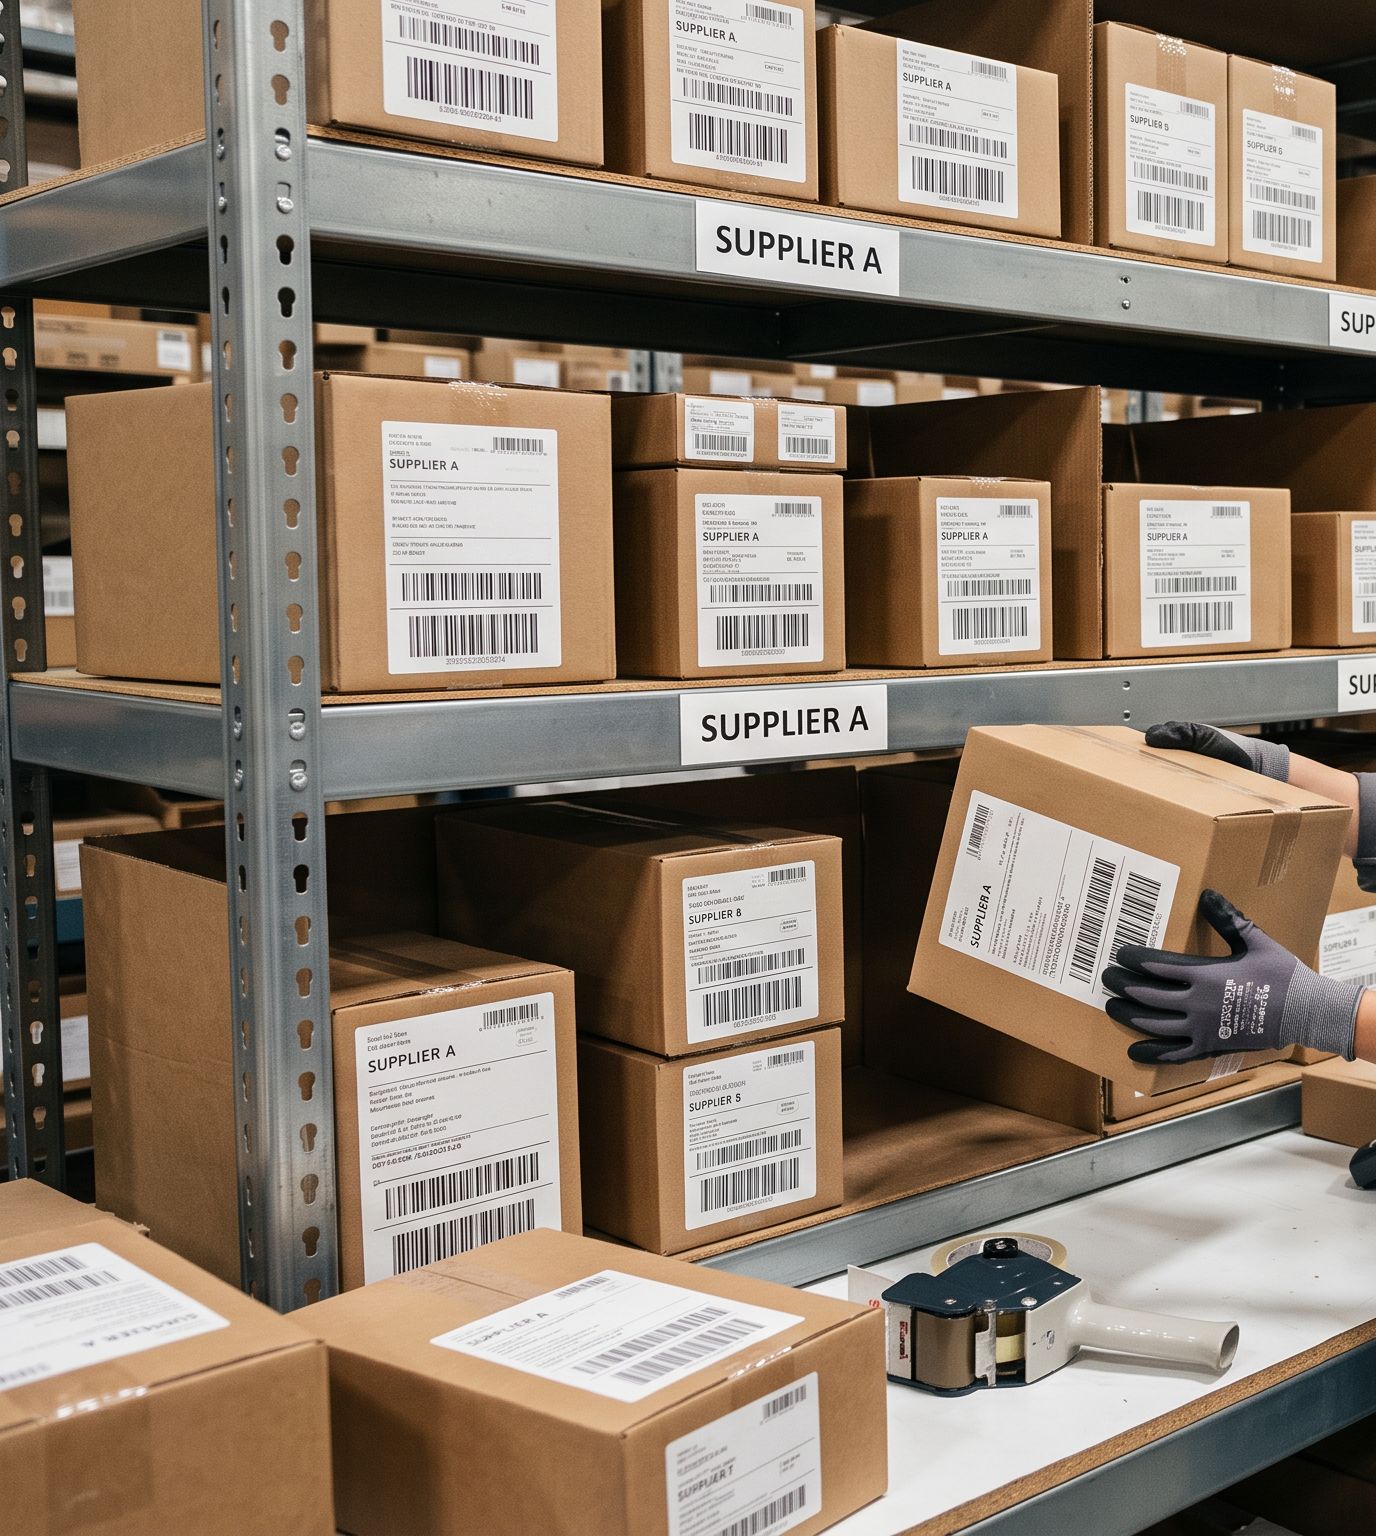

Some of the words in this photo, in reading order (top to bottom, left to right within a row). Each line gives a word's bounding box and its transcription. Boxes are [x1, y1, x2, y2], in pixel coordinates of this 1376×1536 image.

[676, 20, 726, 41] SUPPLIER
[902, 72, 944, 90] SUPPLIER
[945, 82, 952, 92] A
[1130, 114, 1165, 130] SUPPLIER
[716, 225, 855, 271] SUPPLIER
[862, 246, 883, 275] A
[389, 458, 447, 471] SUPPLIER
[450, 460, 459, 471] A
[702, 531, 751, 542] SUPPLIER
[752, 531, 760, 542] A
[941, 531, 981, 541] SUPPLIER
[982, 532, 989, 541] A
[1182, 532, 1188, 541] A
[701, 707, 841, 743] SUPPLIER
[848, 705, 869, 732] A
[689, 909, 733, 926] SUPPLIER
[970, 894, 990, 949] SUPPLIER
[982, 883, 992, 895] A
[368, 1047, 441, 1074] SUPPLIER
[445, 1044, 456, 1058] A
[689, 1094, 733, 1112] SUPPLIER
[535, 1311, 550, 1320] A
